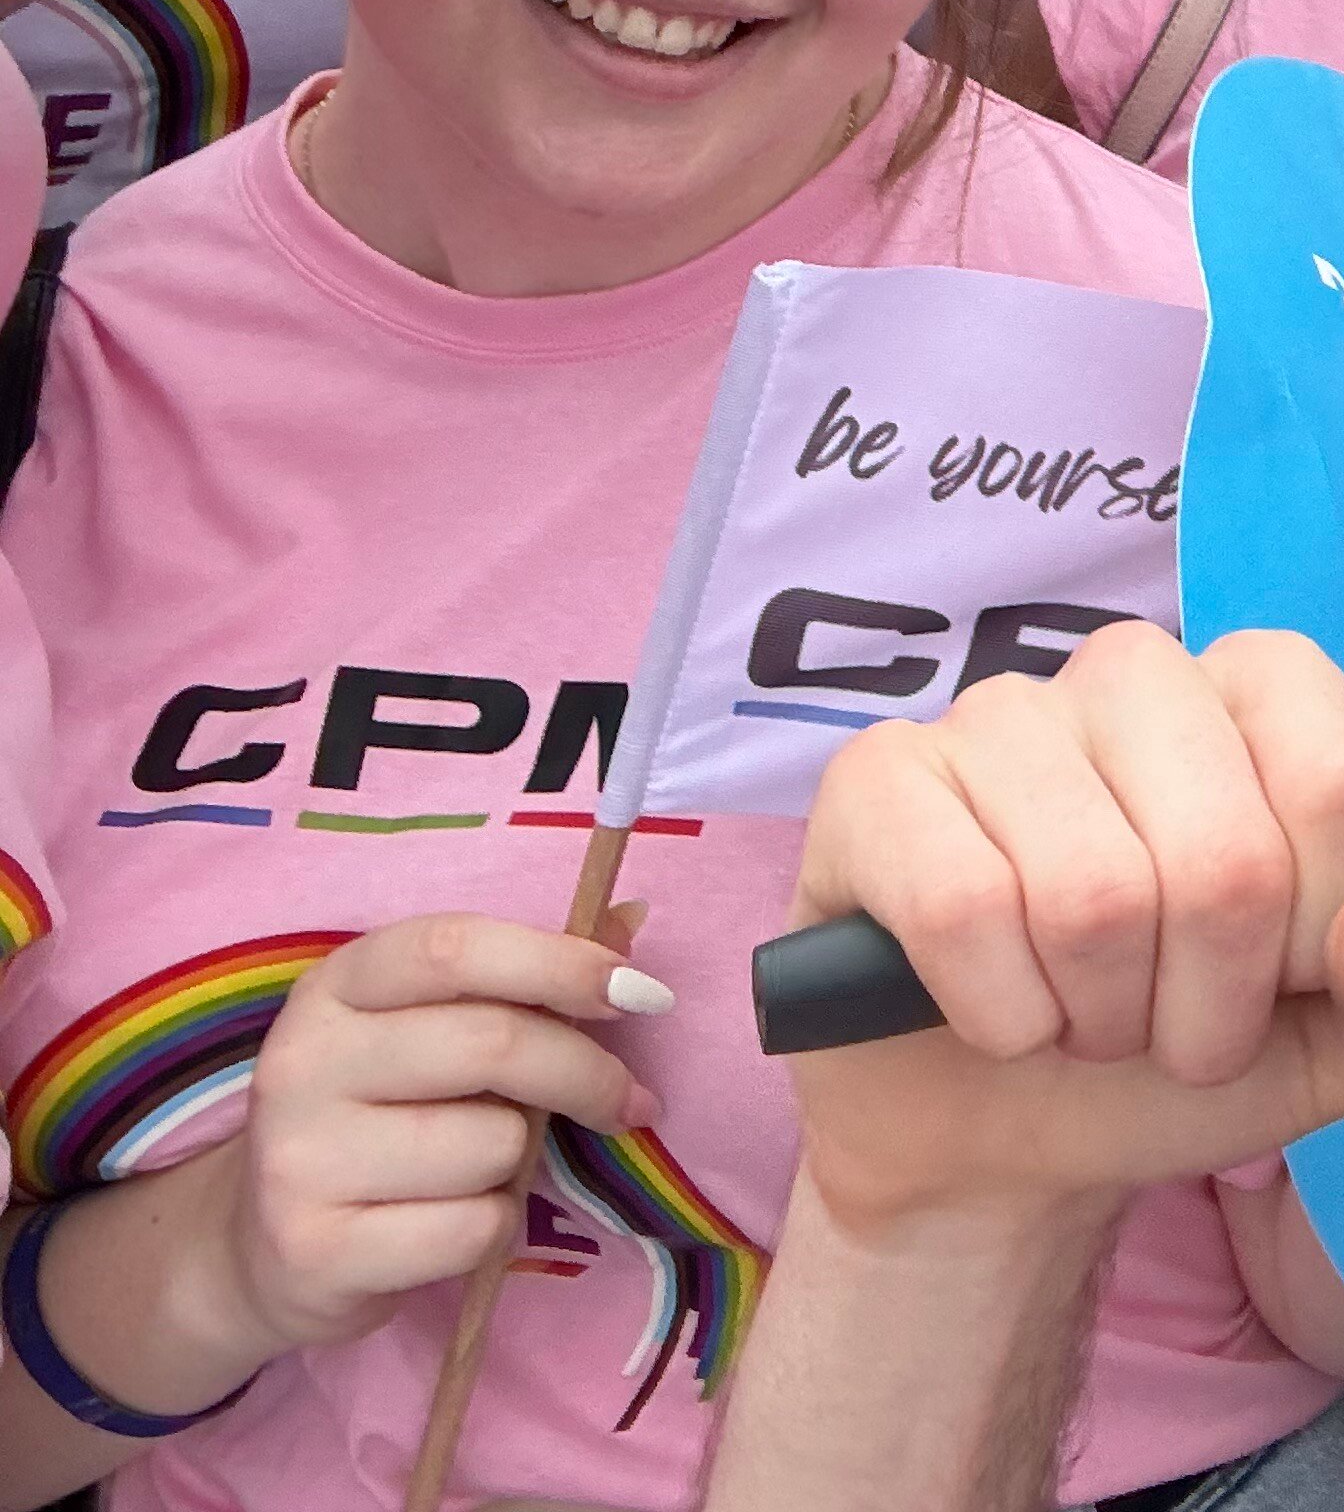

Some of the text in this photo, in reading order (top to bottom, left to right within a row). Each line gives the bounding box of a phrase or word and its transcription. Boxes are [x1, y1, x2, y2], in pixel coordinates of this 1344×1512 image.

[796, 386, 1180, 522] be yourse
[748, 586, 1147, 704] CP
